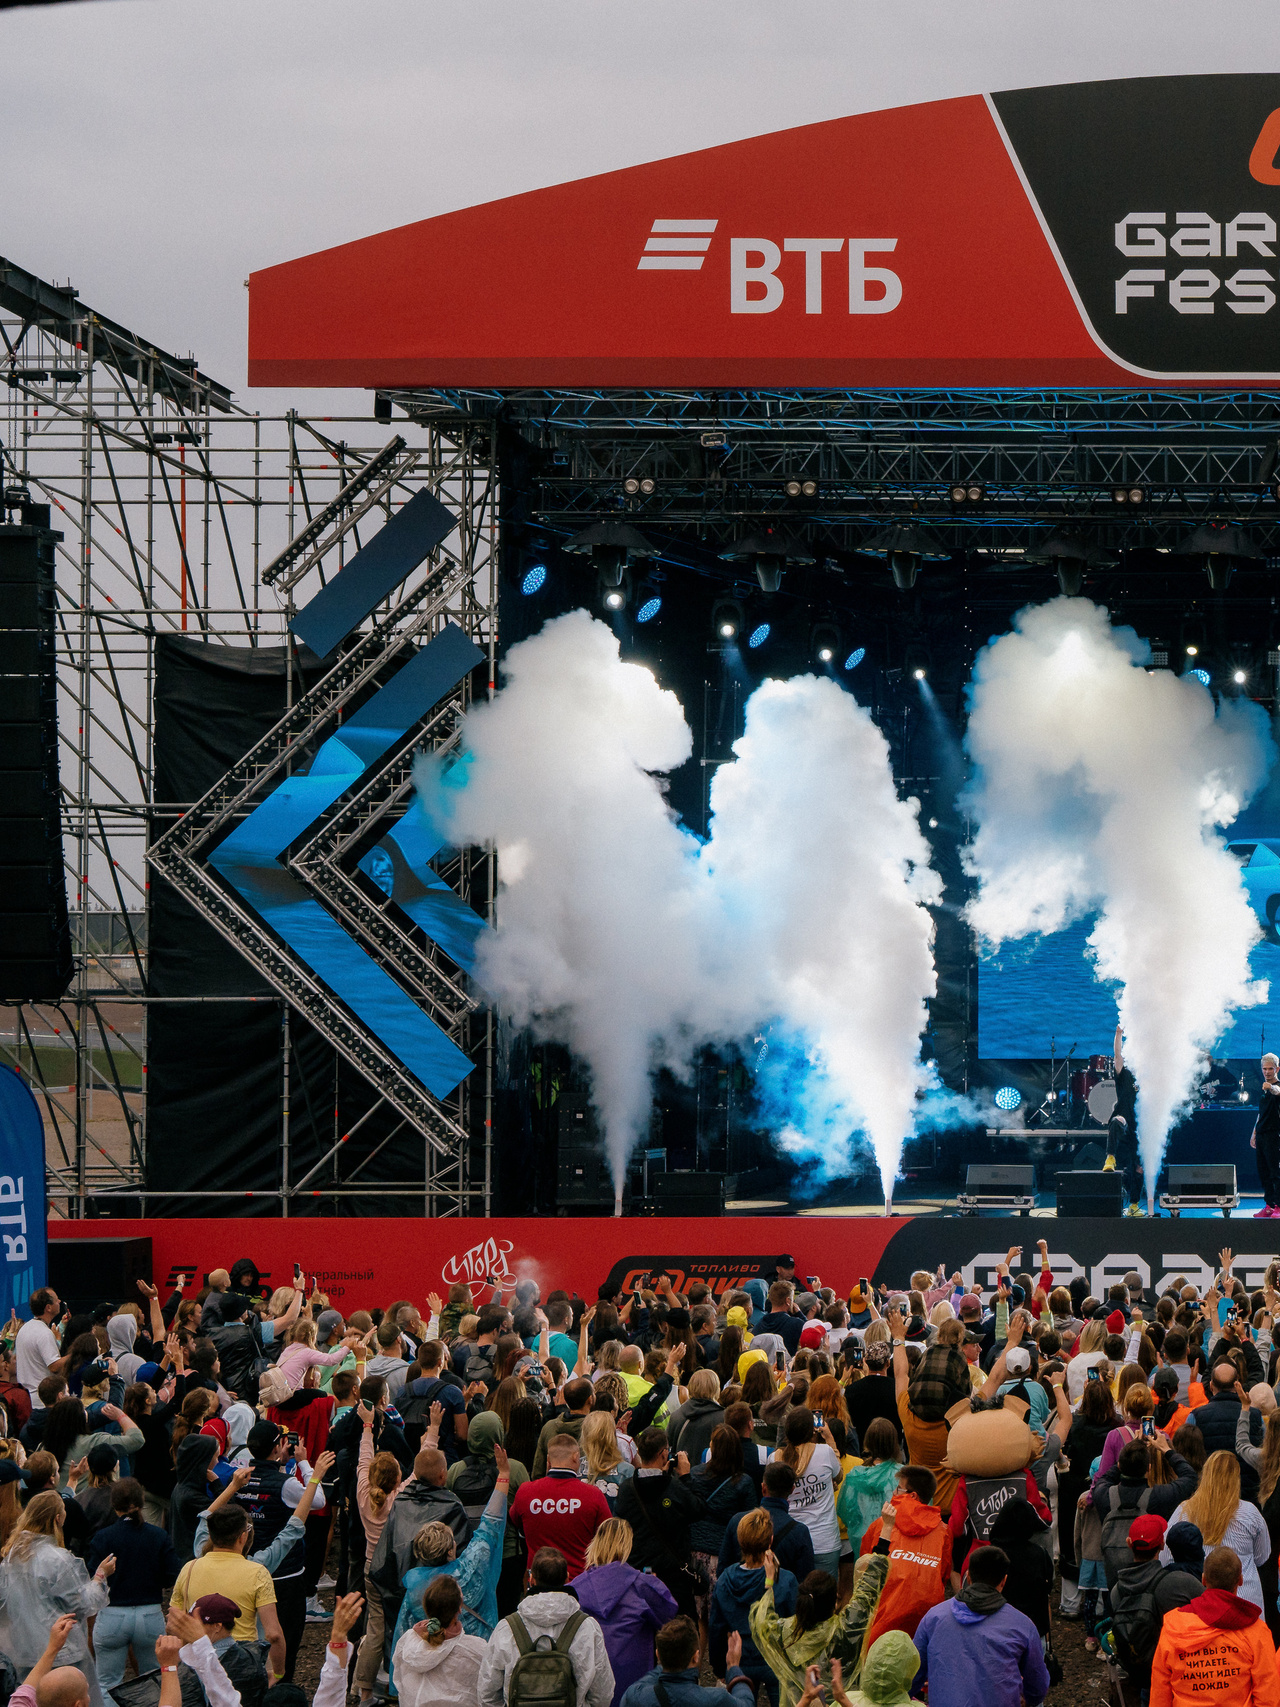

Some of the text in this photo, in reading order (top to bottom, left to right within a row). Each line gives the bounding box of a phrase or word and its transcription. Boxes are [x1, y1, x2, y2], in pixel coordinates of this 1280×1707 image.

[730, 237, 903, 314] ВТБ
[301, 1268, 374, 1281] енеральный
[794, 1474, 818, 1488] ВТО
[529, 1498, 571, 1514] СССР
[1203, 1647, 1218, 1656] ВЫ
[1220, 1645, 1239, 1654] ЭТО
[1181, 1667, 1241, 1680] НАЧИТ ИДЕТ
[1192, 1681, 1230, 1692] ДОЖДЬ
